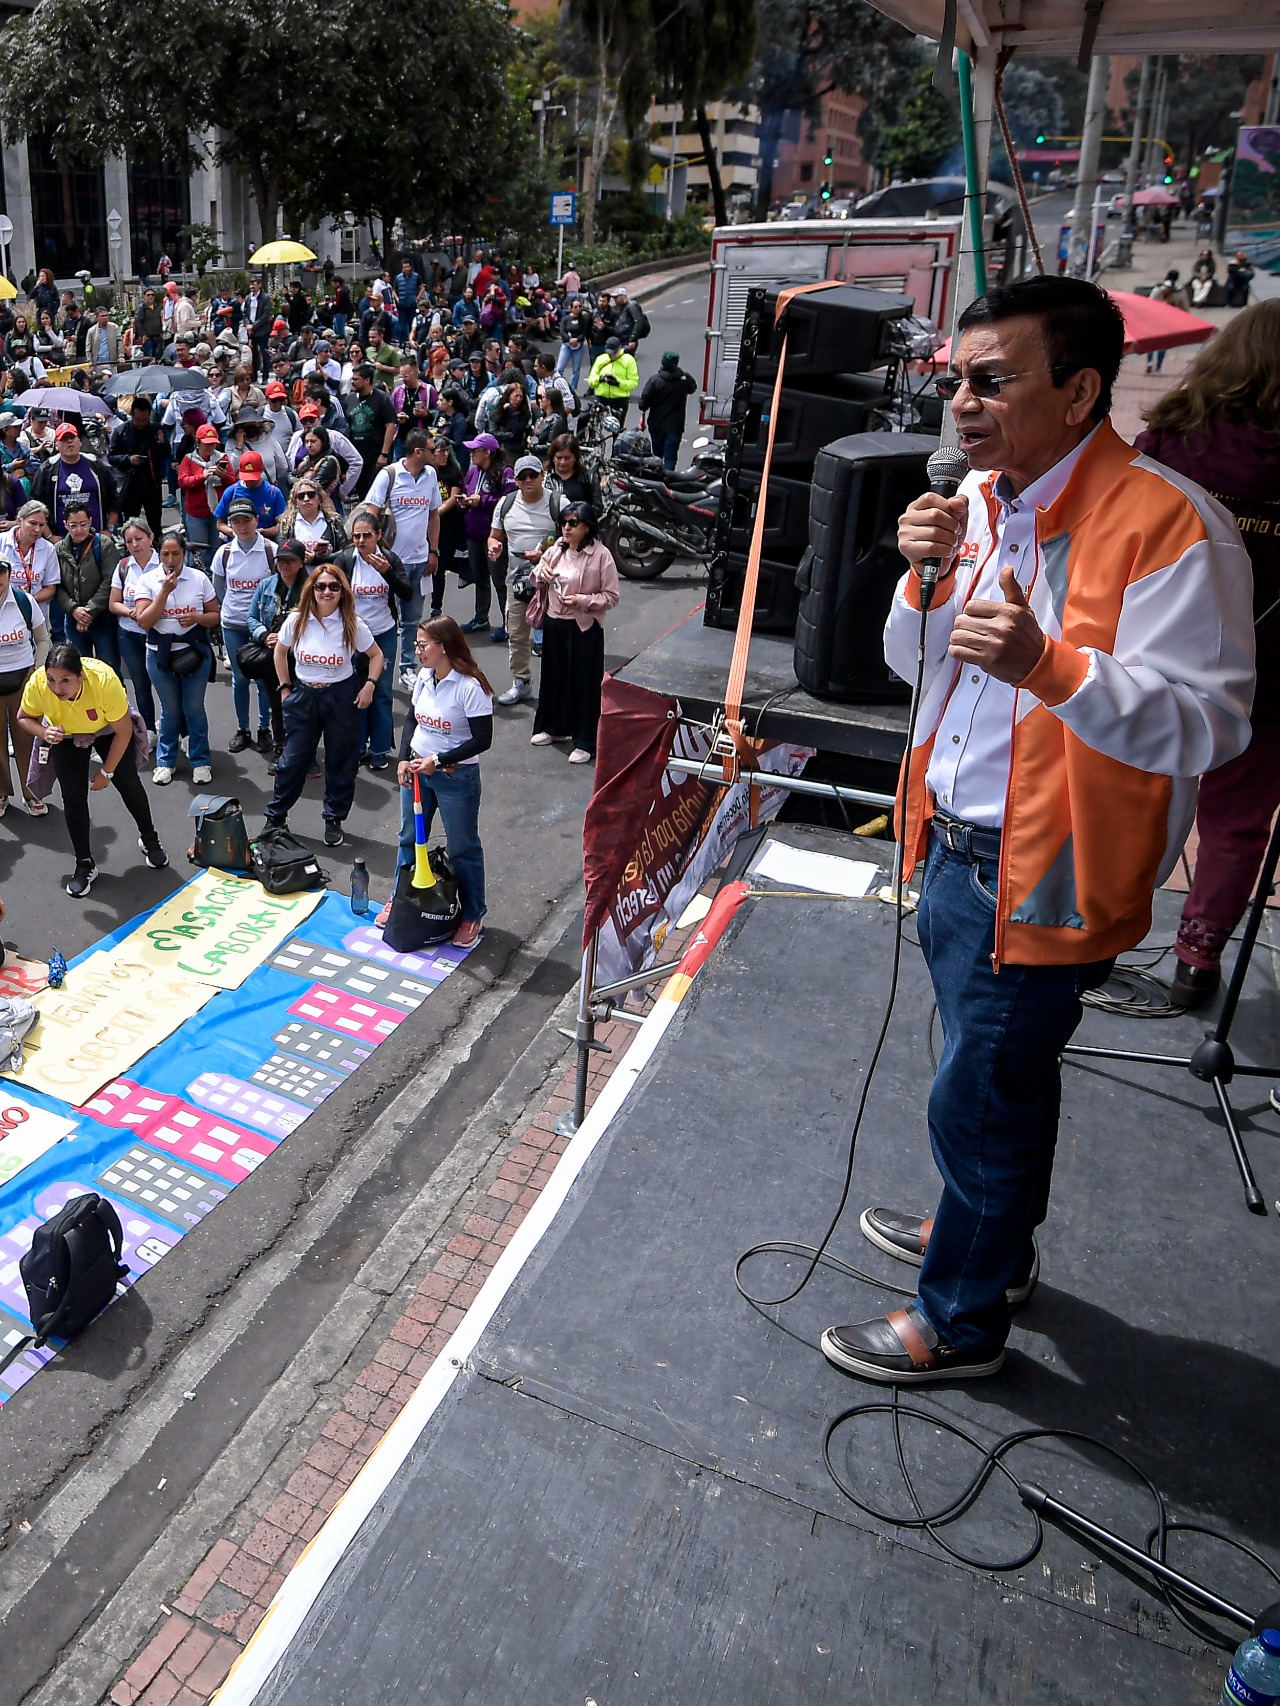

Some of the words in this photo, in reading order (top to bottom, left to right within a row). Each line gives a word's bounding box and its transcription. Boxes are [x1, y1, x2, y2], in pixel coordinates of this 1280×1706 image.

[398, 496, 430, 507] fecode
[299, 652, 345, 667] fecode
[146, 879, 255, 951] MASACRE
[176, 900, 301, 978] LABORAL
